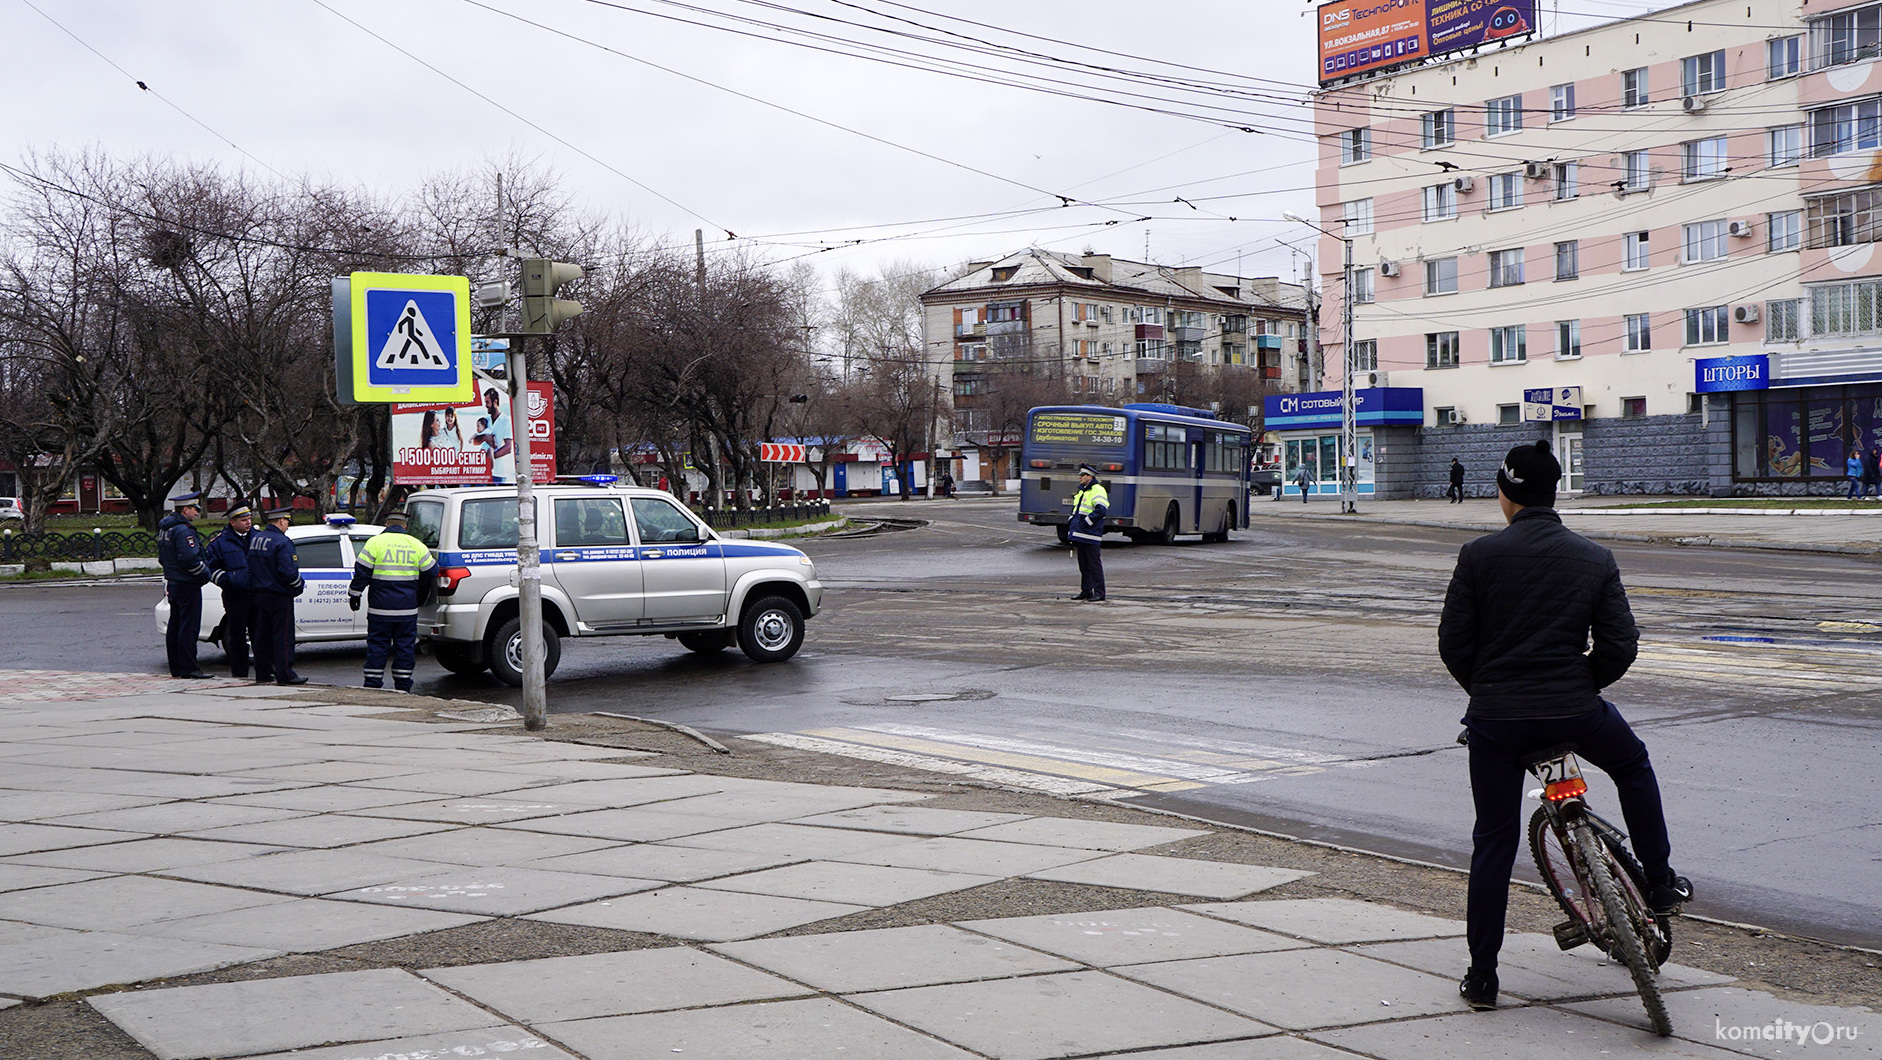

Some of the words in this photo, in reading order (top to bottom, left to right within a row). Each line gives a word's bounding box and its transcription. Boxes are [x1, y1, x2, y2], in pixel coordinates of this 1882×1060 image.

[1324, 9, 1350, 26] DNS
[1431, 7, 1469, 27] ТЕХНИКА
[1433, 31, 1462, 45] Оптовые
[1463, 21, 1484, 35] цены!
[1703, 364, 1760, 383] ШТОРЫ
[1280, 398, 1298, 413] СМ
[1301, 397, 1343, 409] СОТОВЫЙ
[1114, 420, 1124, 429] 31
[1092, 435, 1122, 443] 34-30-10
[408, 448, 431, 466] 500
[433, 448, 455, 466] 000
[458, 450, 487, 465] СЕМЕЙ
[530, 452, 553, 461] atimir.ru
[430, 466, 460, 475] ВЫБИРАЮТ
[462, 466, 487, 475] РАТИМИР
[250, 537, 271, 551] ДПС
[382, 549, 416, 563] ДПС
[667, 548, 707, 556] ПОЛИЦИЯ
[1541, 759, 1566, 784] 27
